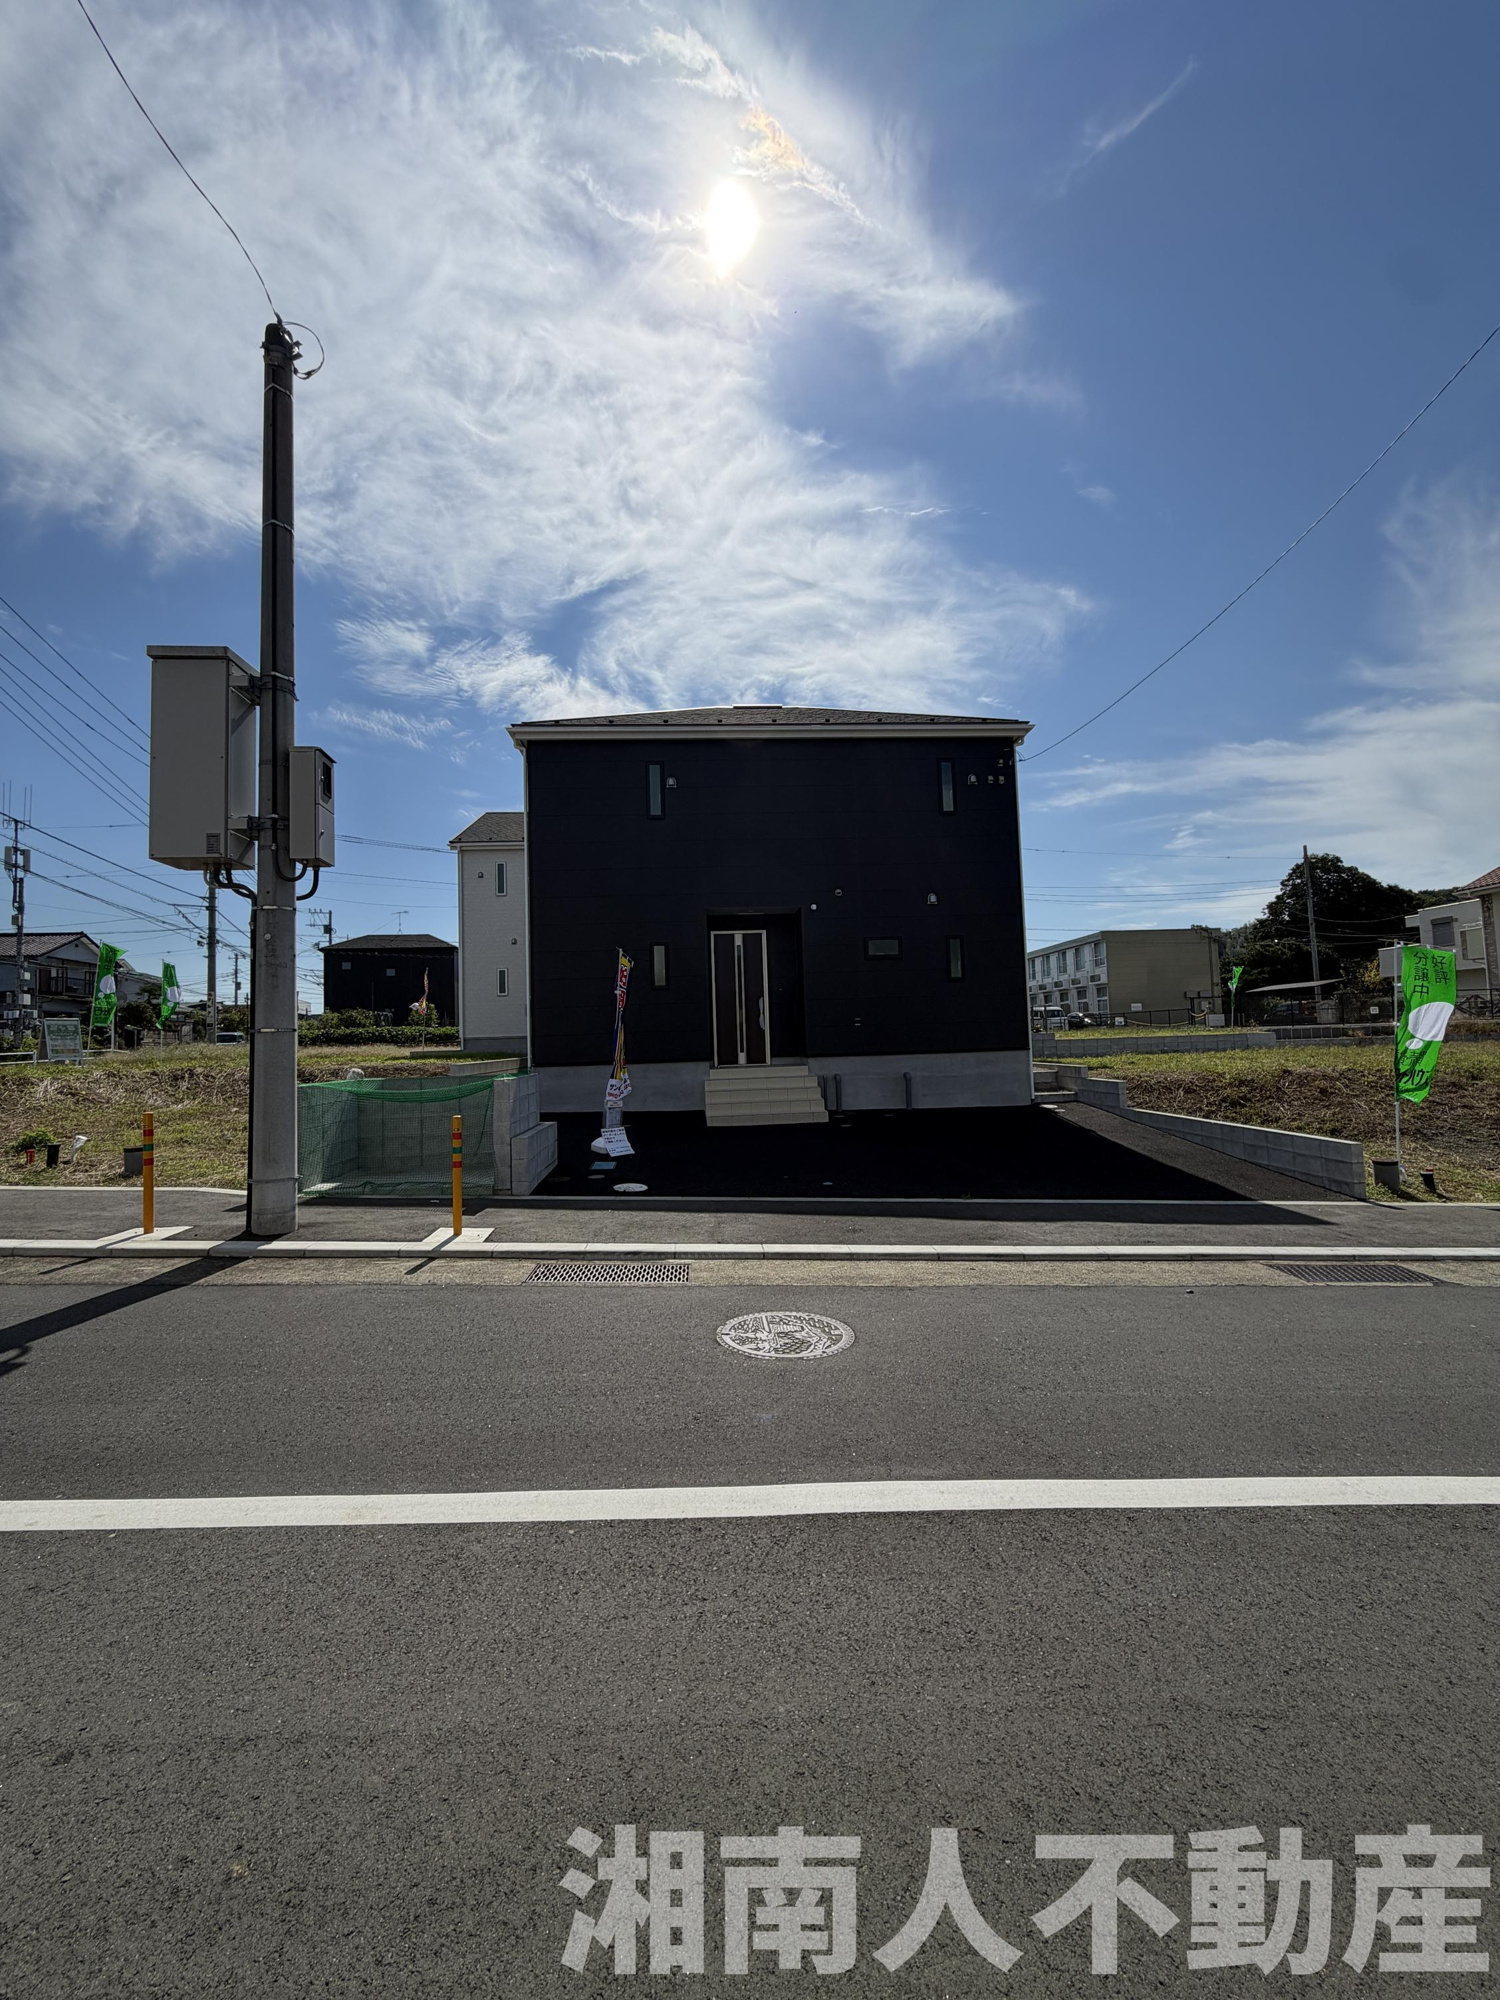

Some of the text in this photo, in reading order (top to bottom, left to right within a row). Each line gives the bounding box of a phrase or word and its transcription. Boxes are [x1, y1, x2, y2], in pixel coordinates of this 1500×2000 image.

[1413, 952, 1429, 999] 分譲中
[1431, 954, 1450, 985] 好評
